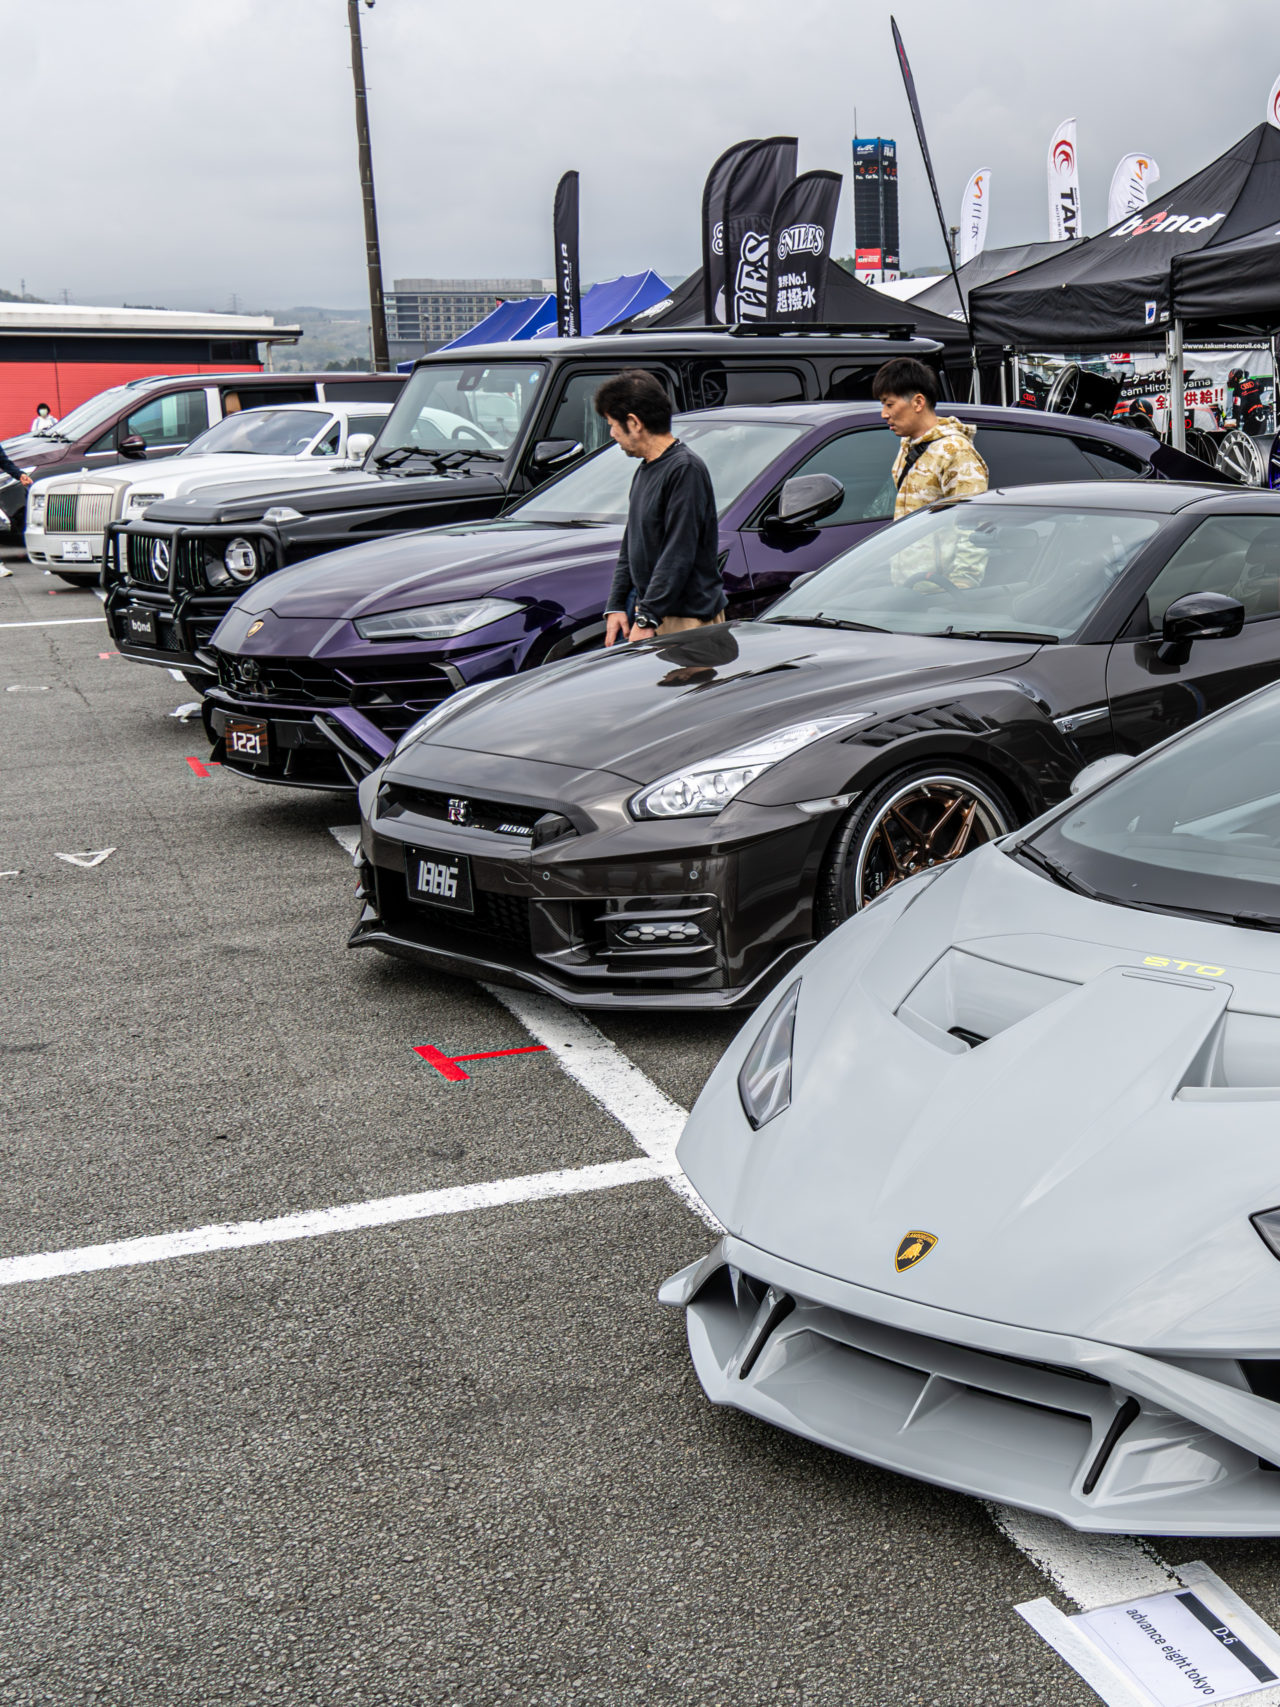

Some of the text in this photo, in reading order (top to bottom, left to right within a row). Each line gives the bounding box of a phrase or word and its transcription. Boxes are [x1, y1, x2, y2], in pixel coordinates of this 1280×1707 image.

[1109, 211, 1226, 238] bond
[778, 223, 825, 260] NILES
[561, 243, 572, 310] HOUR
[1155, 388, 1224, 410] 全供給!!
[232, 731, 261, 754] 1221
[1142, 956, 1227, 977] STO
[1213, 1627, 1238, 1645] D-6
[1126, 1608, 1215, 1695] advance eight tokyo
